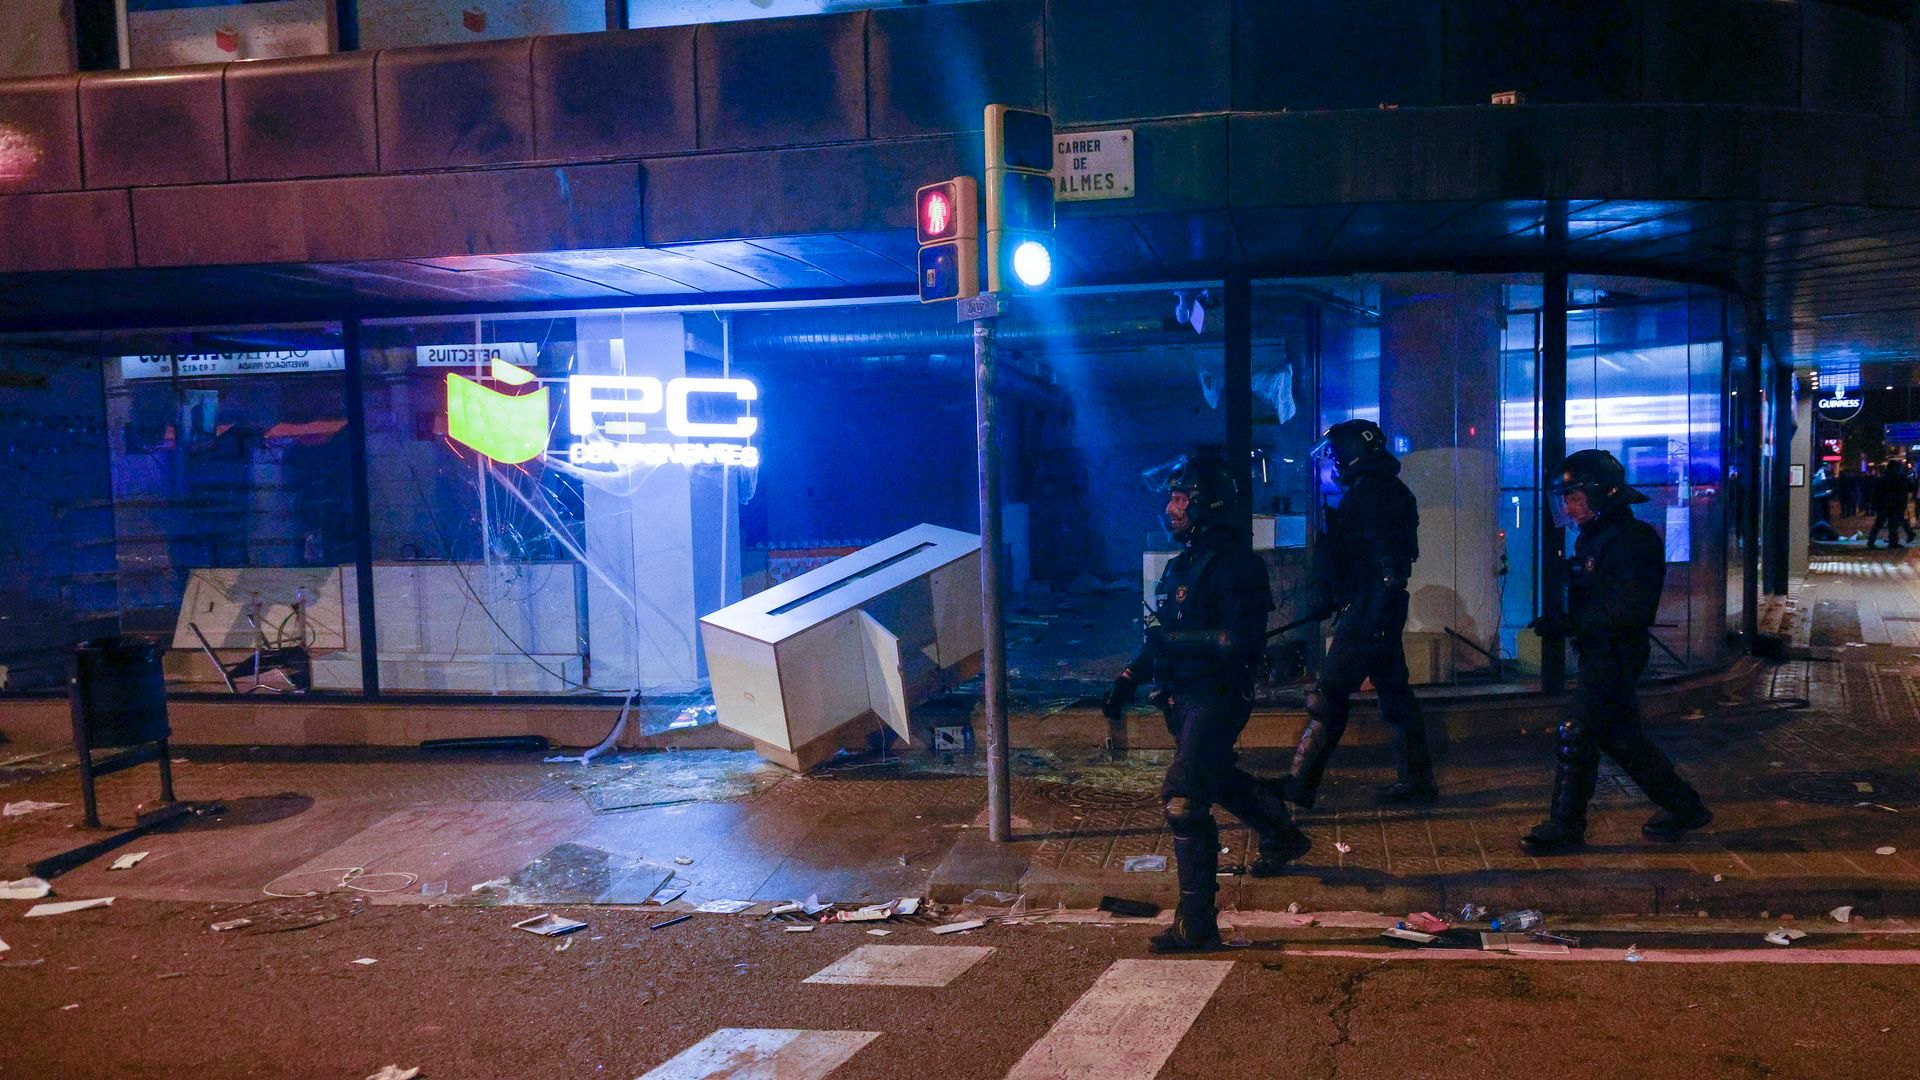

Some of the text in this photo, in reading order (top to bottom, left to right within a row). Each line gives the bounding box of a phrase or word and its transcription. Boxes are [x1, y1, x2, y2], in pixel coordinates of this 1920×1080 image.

[1058, 139, 1101, 154] CARRER
[1073, 157, 1088, 170] DE
[1054, 173, 1115, 193] ALMES
[569, 375, 758, 437] PC
[1818, 399, 1860, 409] GUINNESS
[1361, 430, 1374, 442] D
